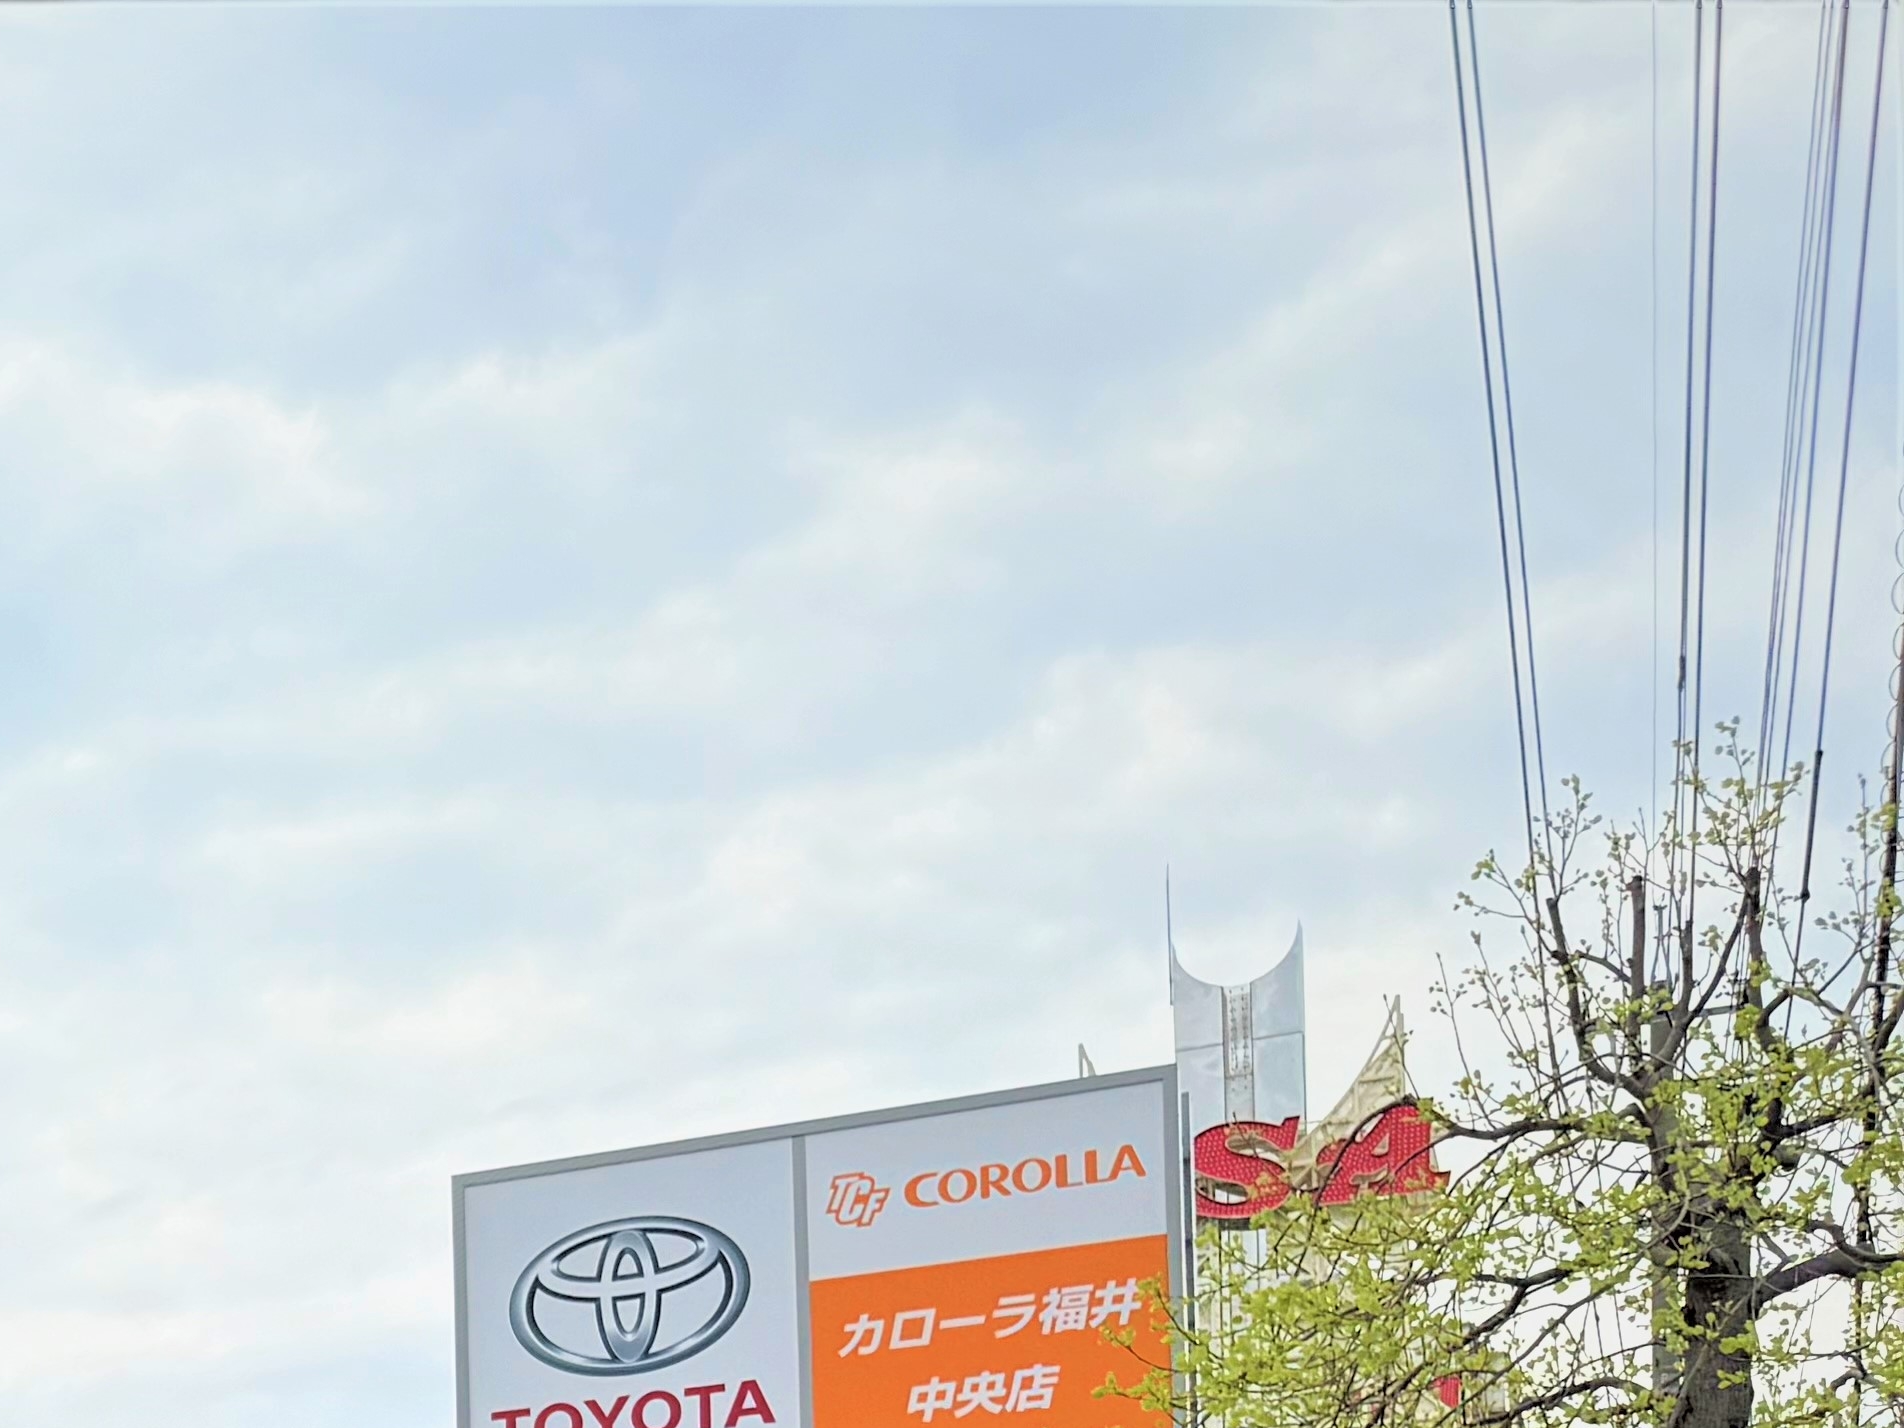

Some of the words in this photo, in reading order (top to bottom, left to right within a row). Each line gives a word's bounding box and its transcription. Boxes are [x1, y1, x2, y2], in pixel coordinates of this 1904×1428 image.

[903, 1144, 1146, 1207] COROLLA
[837, 1278, 1142, 1358] カローラ福井
[906, 1363, 1061, 1423] 中央店
